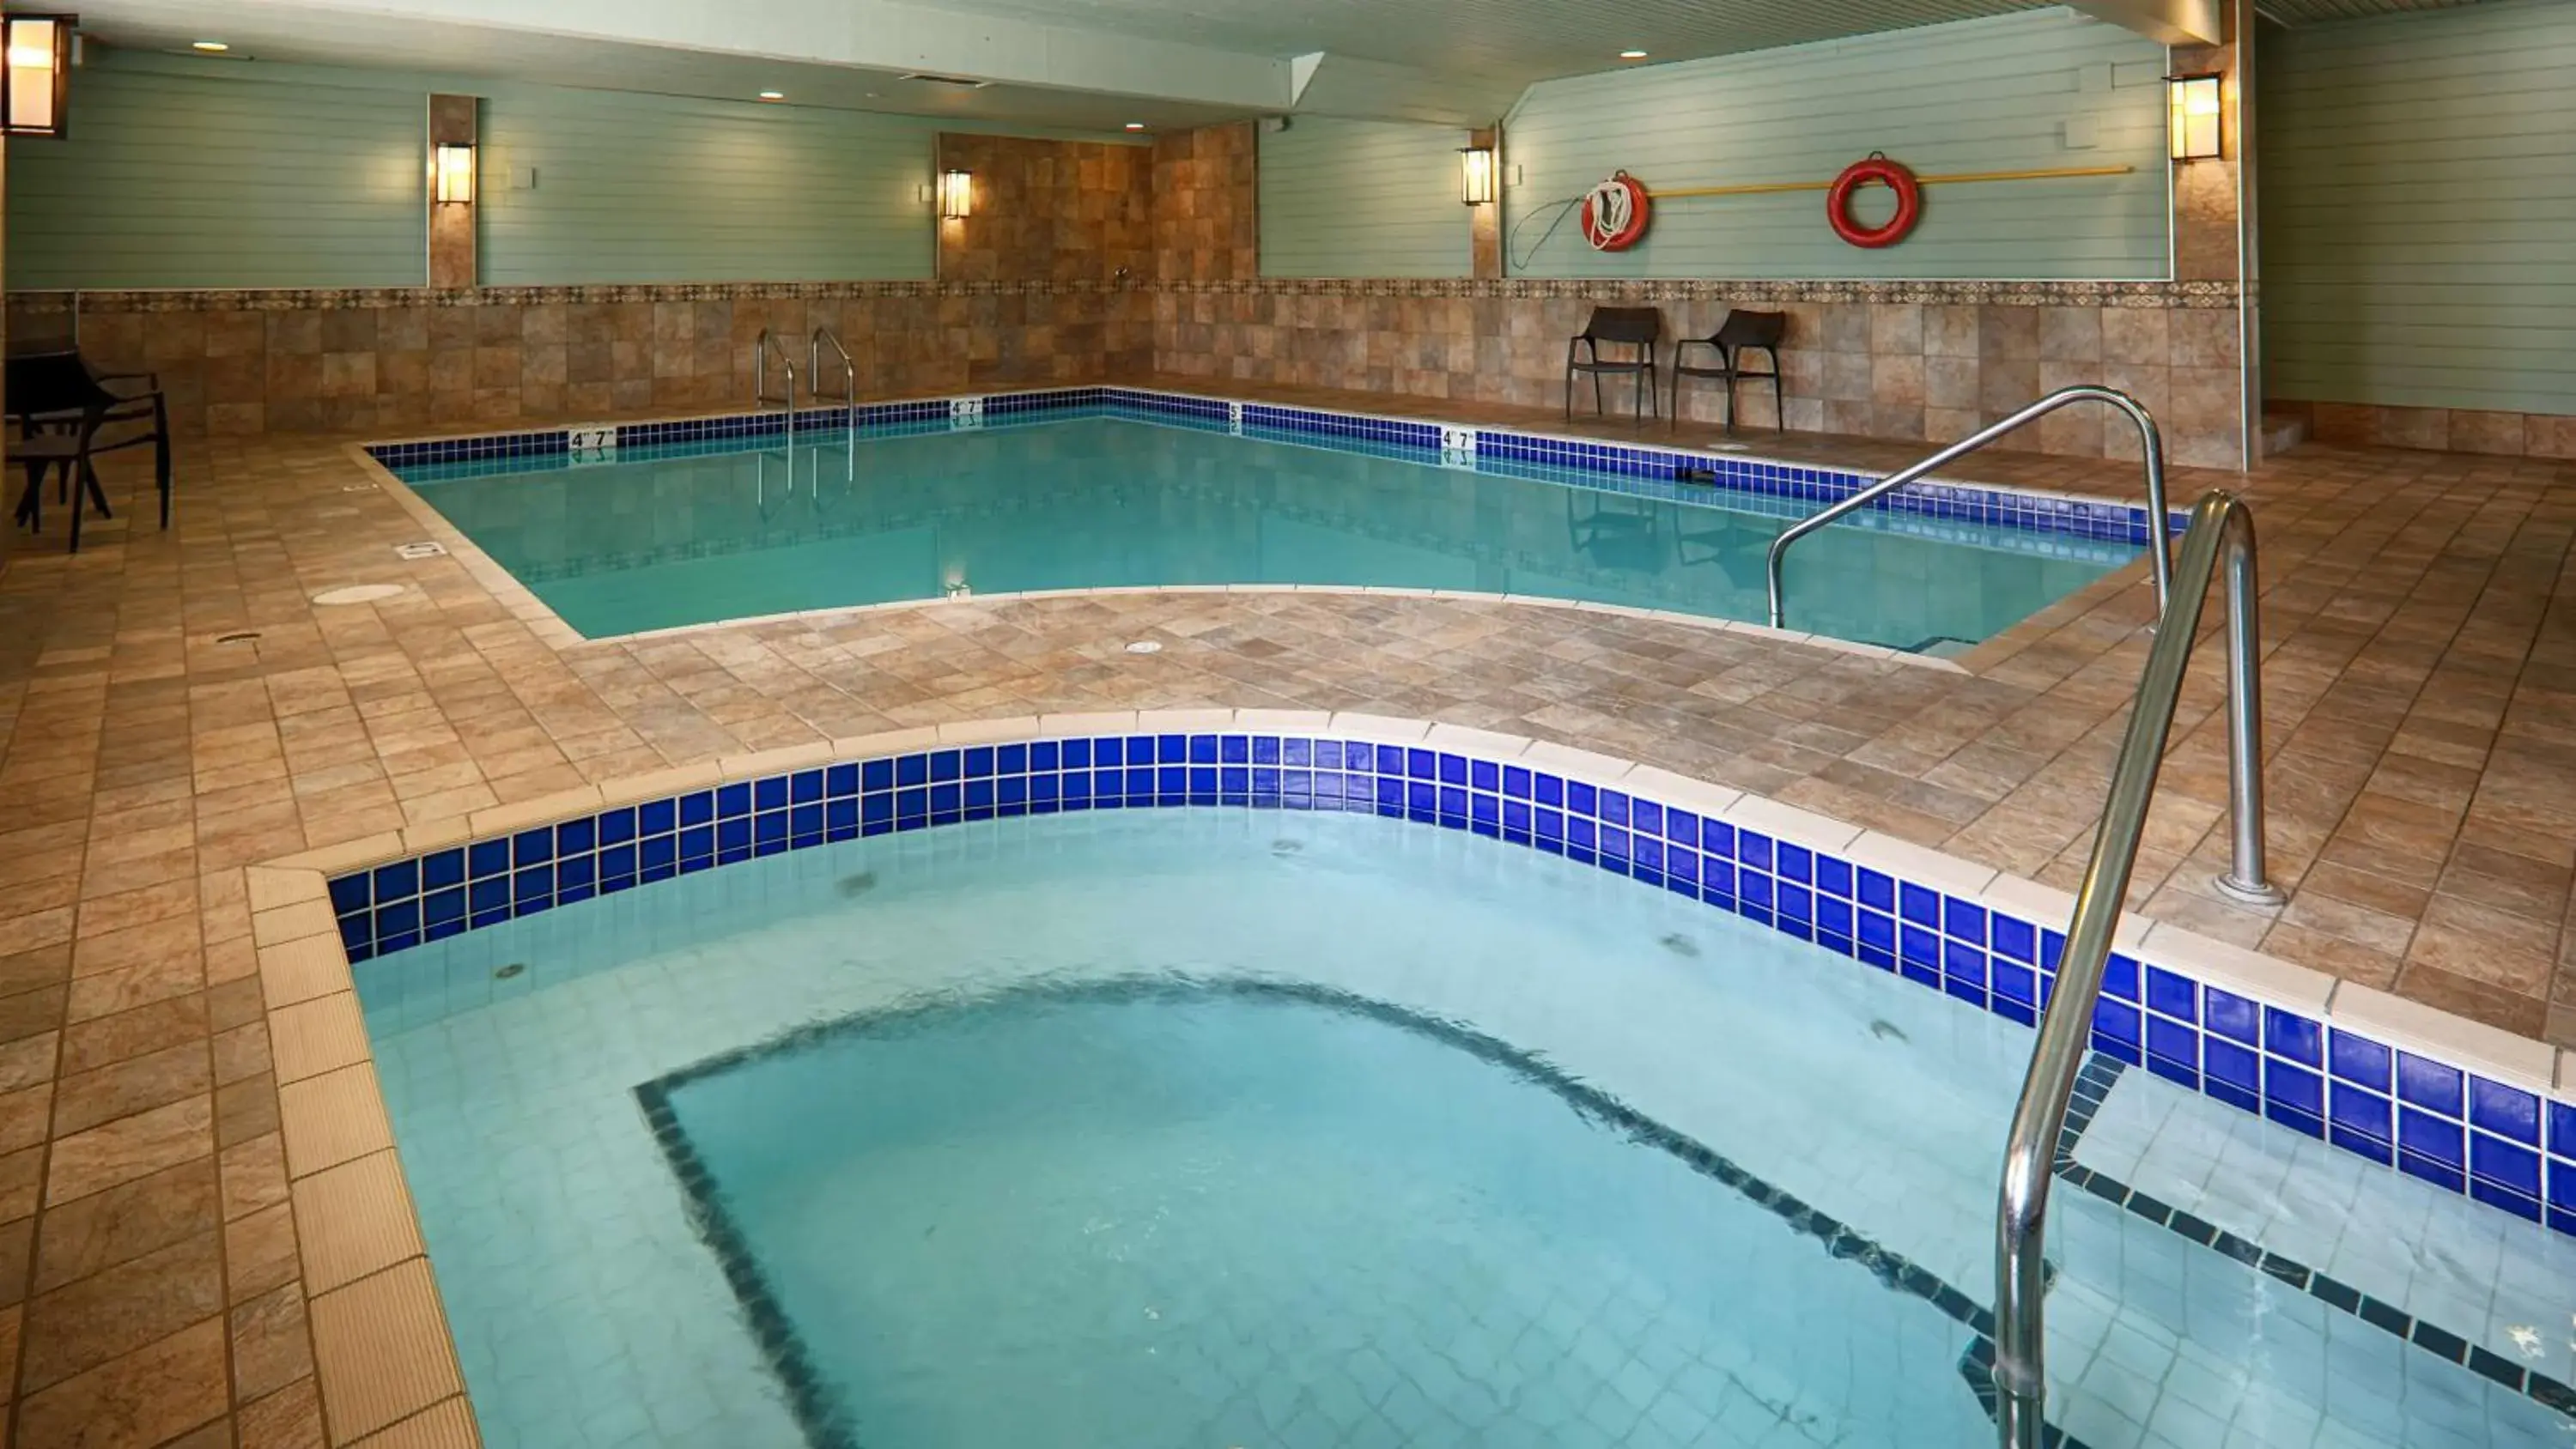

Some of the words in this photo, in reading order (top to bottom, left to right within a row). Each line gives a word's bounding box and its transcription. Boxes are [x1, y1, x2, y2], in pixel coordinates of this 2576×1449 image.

[969, 401, 975, 413] 7
[595, 431, 605, 446] 7
[1443, 431, 1451, 446] 4
[1460, 433, 1467, 447] 7
